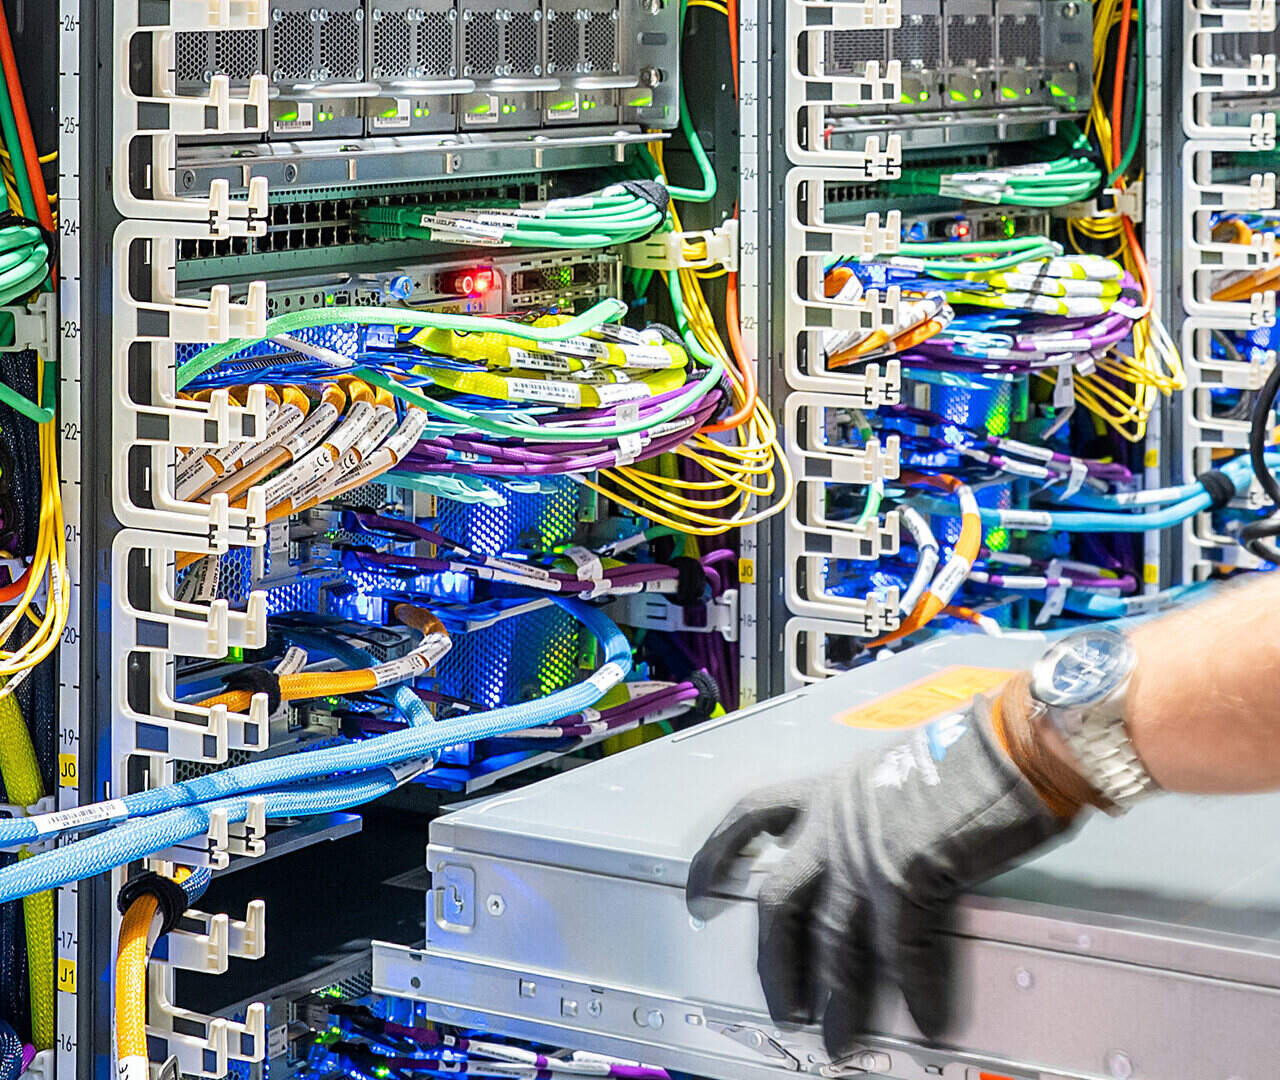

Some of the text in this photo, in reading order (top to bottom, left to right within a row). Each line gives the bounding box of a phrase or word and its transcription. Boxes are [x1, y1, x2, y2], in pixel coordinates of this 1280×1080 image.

[64, 15, 76, 31] 26
[744, 18, 754, 31] 26
[744, 93, 753, 106] 25
[64, 117, 75, 133] 25
[744, 168, 754, 180] 24
[64, 219, 76, 236] 24
[744, 243, 754, 255] 23
[64, 321, 77, 338] 23
[744, 317, 754, 329] 22
[65, 423, 77, 440] 22
[65, 525, 76, 542] 21
[741, 565, 753, 577] J0
[64, 627, 76, 643] 20
[62, 728, 74, 745] 19
[61, 762, 76, 777] J0
[61, 932, 73, 948] 17
[61, 968, 75, 984] J1
[60, 1035, 72, 1052] 16
